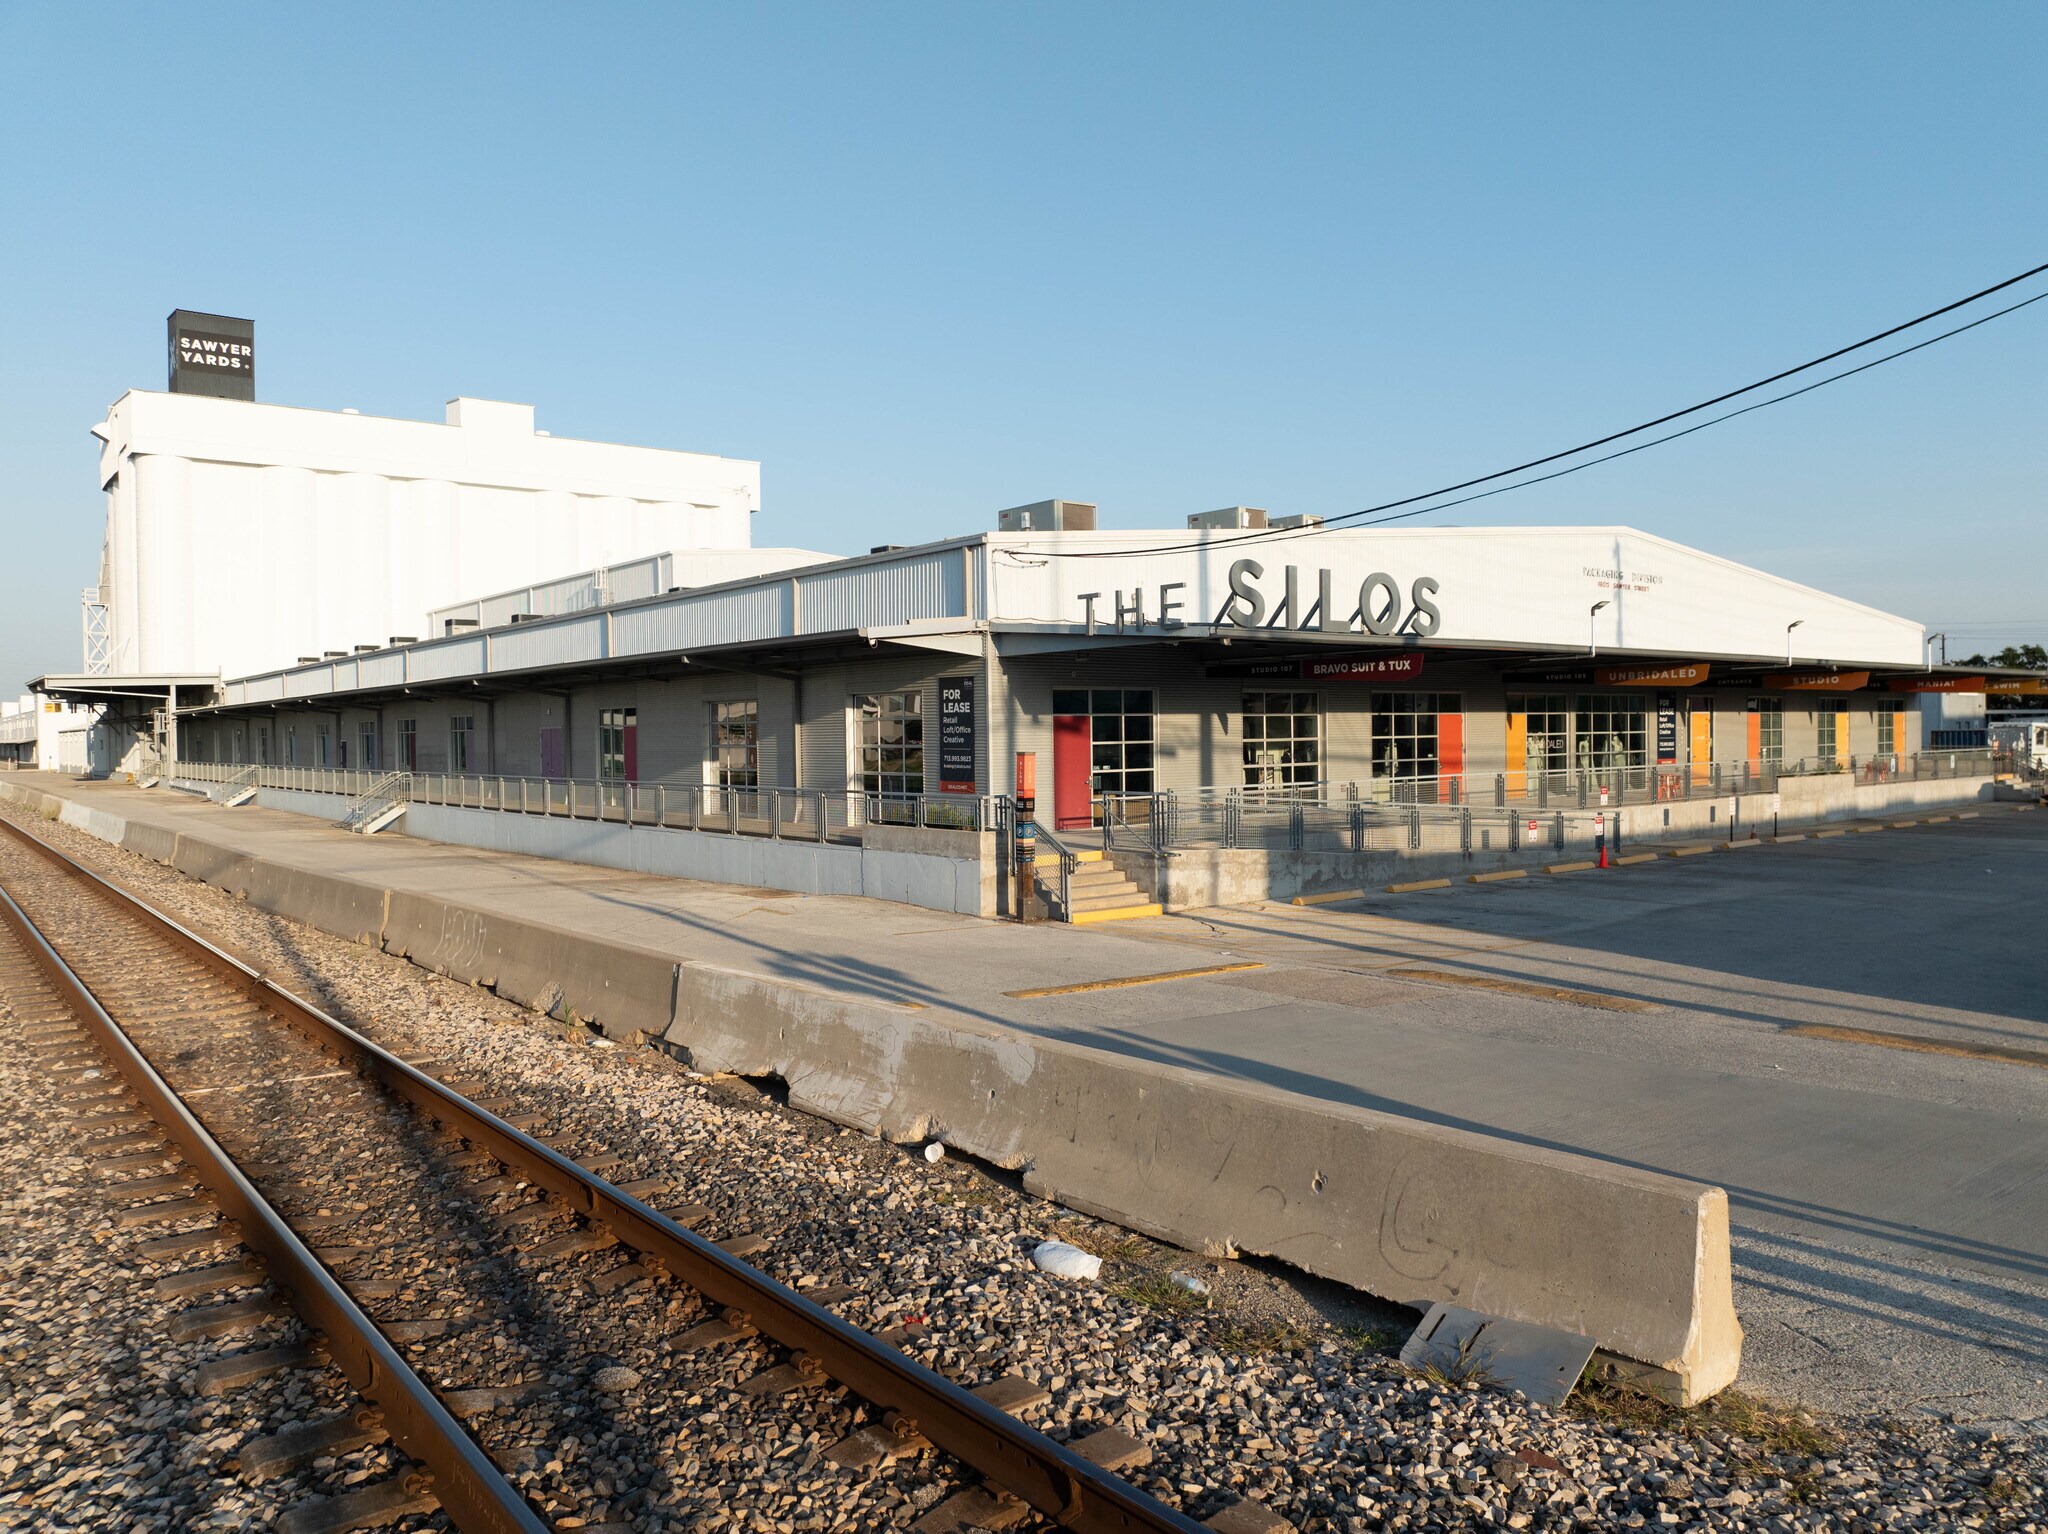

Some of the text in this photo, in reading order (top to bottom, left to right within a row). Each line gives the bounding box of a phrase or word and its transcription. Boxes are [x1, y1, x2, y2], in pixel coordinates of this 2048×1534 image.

[180, 337, 251, 356] SAWYER
[180, 351, 250, 369] YARDS.
[1582, 566, 1624, 580] PACKAGING
[1077, 558, 1441, 637] THE SILOS
[1313, 660, 1411, 674] BRAVO SUIT & TUX
[1609, 668, 1697, 681] UNBRIDALED
[1792, 675, 1840, 685] STUDIO
[943, 689, 961, 700] FOR
[943, 702, 971, 713] LEASE
[943, 716, 958, 724] Retail
[943, 726, 972, 734] Loft/Office
